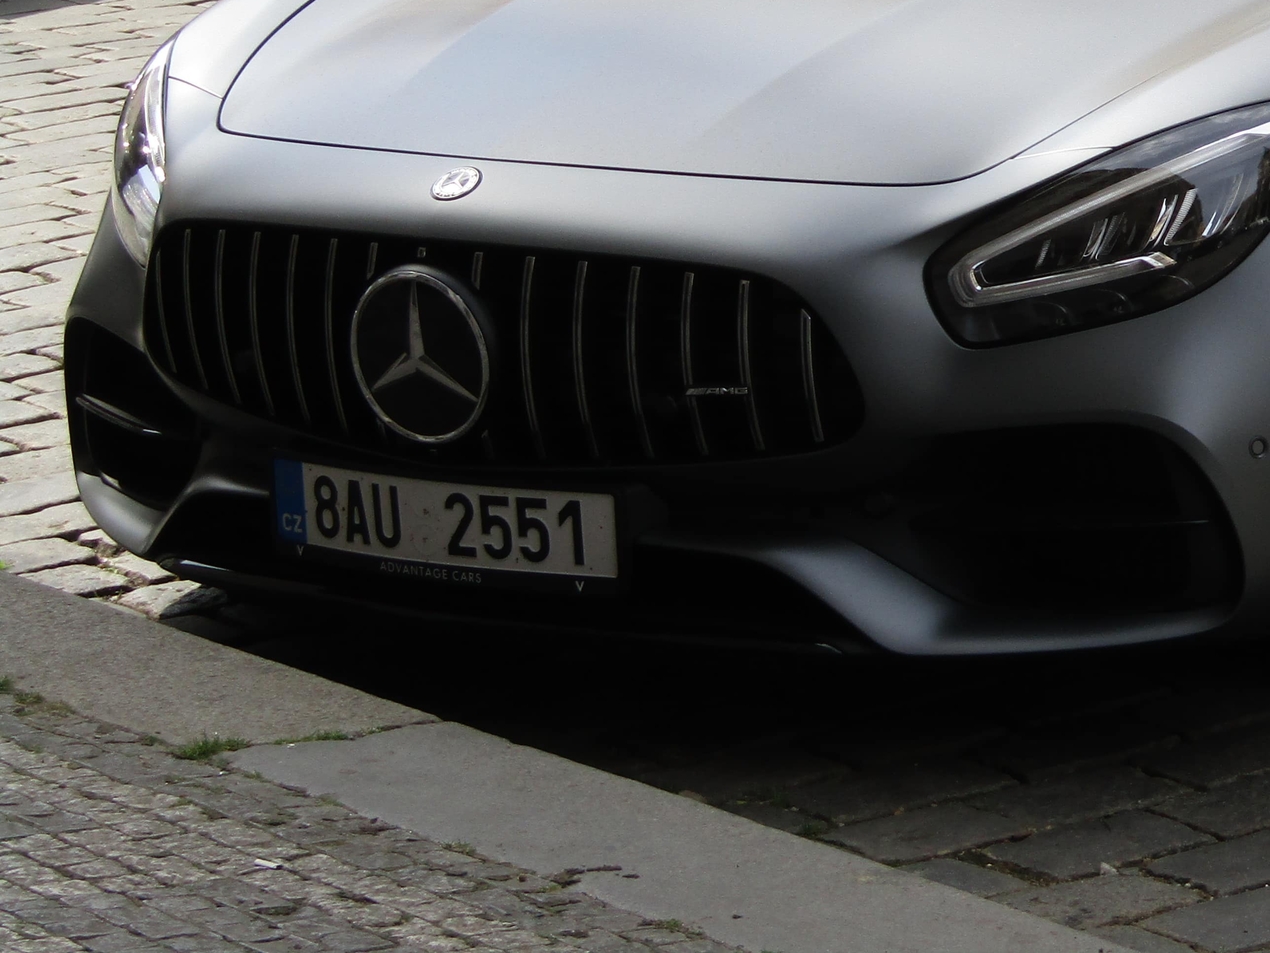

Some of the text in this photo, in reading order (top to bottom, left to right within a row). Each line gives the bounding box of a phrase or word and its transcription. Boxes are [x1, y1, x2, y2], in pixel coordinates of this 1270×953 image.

[282, 513, 303, 533] CZ
[314, 475, 586, 567] 8AU 2551
[380, 561, 482, 584] ADVANTAGE CARS
